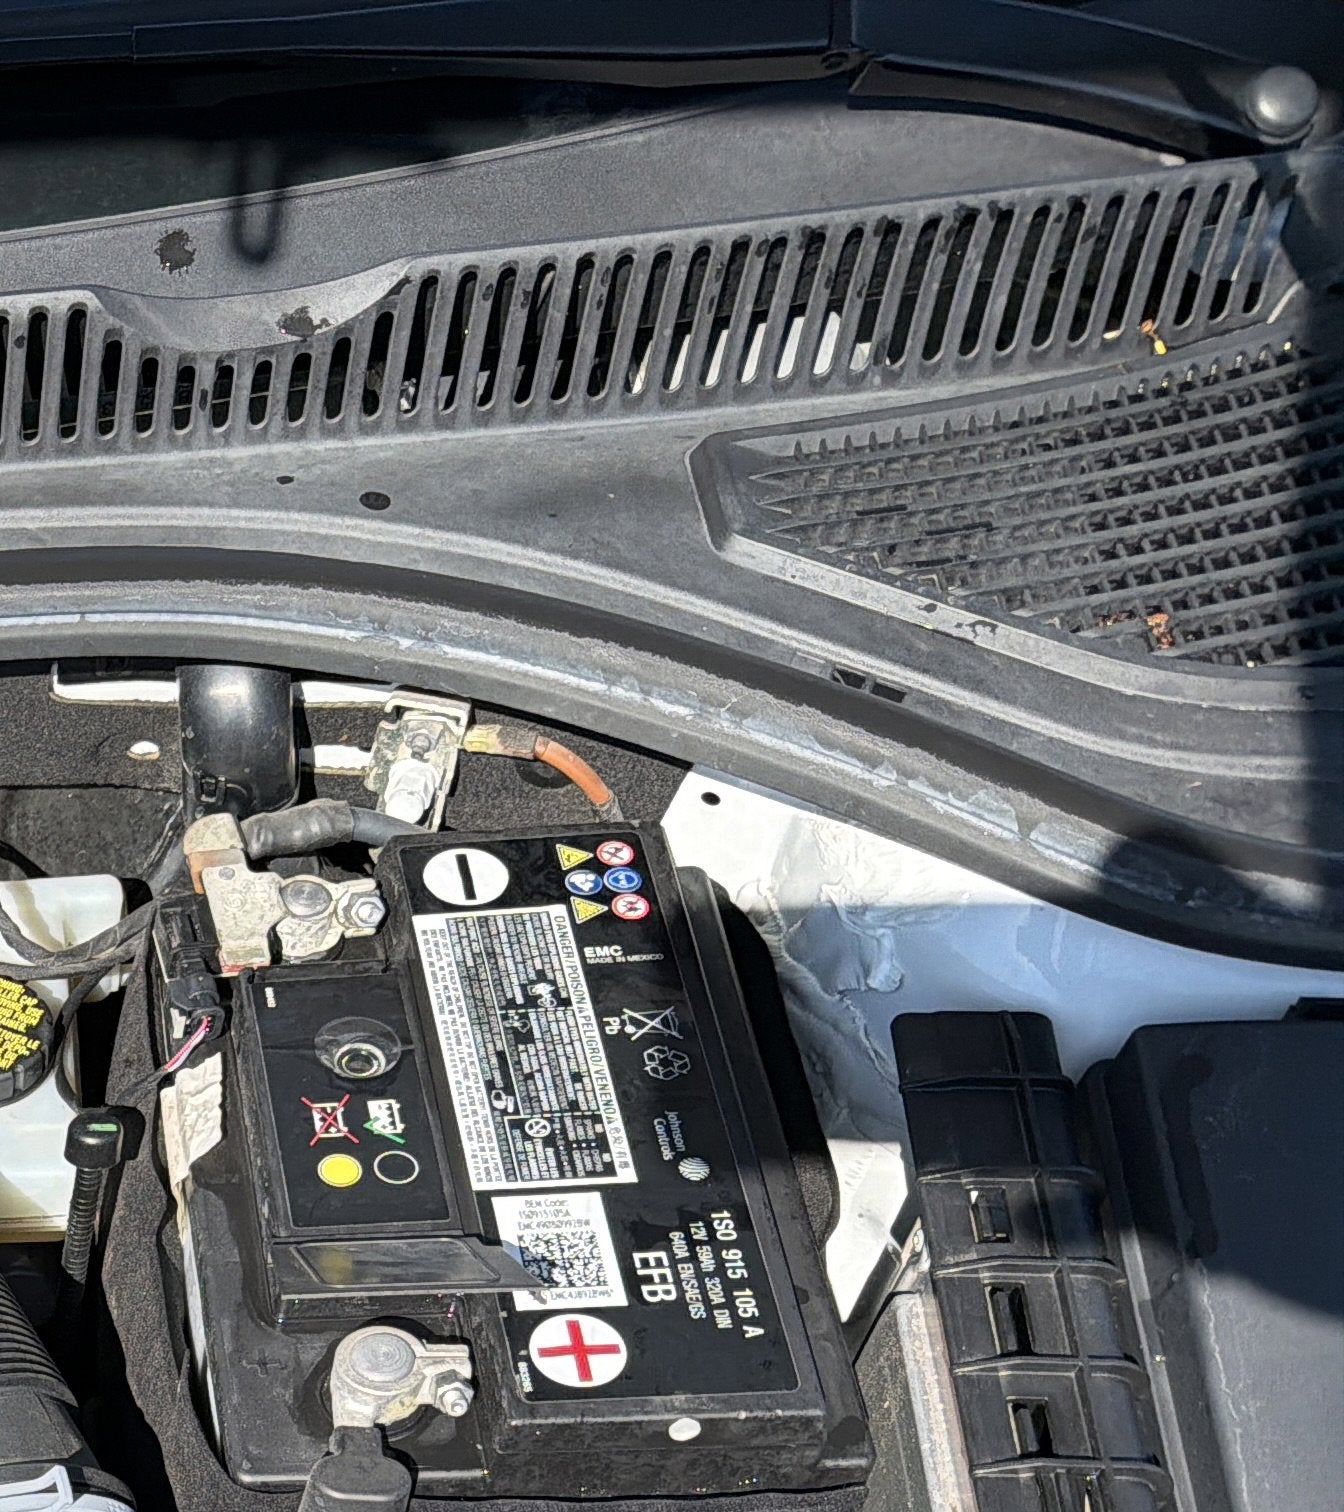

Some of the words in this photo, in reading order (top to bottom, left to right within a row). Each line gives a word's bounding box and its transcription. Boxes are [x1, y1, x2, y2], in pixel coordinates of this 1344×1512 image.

[584, 945, 623, 957] EMC
[19, 995, 38, 1007] CAP
[602, 1016, 623, 1034] Pb
[652, 1117, 675, 1160] Controls
[663, 1110, 688, 1151] Johnson
[667, 1231, 689, 1258] 640A
[688, 1220, 708, 1241] 12V
[695, 1244, 716, 1272] 59Ah
[720, 1248, 748, 1280] 915
[631, 1250, 679, 1303] EFB
[703, 1276, 726, 1305] 320A
[676, 1262, 706, 1320] EN/SAE/GS
[731, 1287, 759, 1318] 105
[712, 1308, 733, 1329] DIN
[741, 1323, 766, 1338] A
